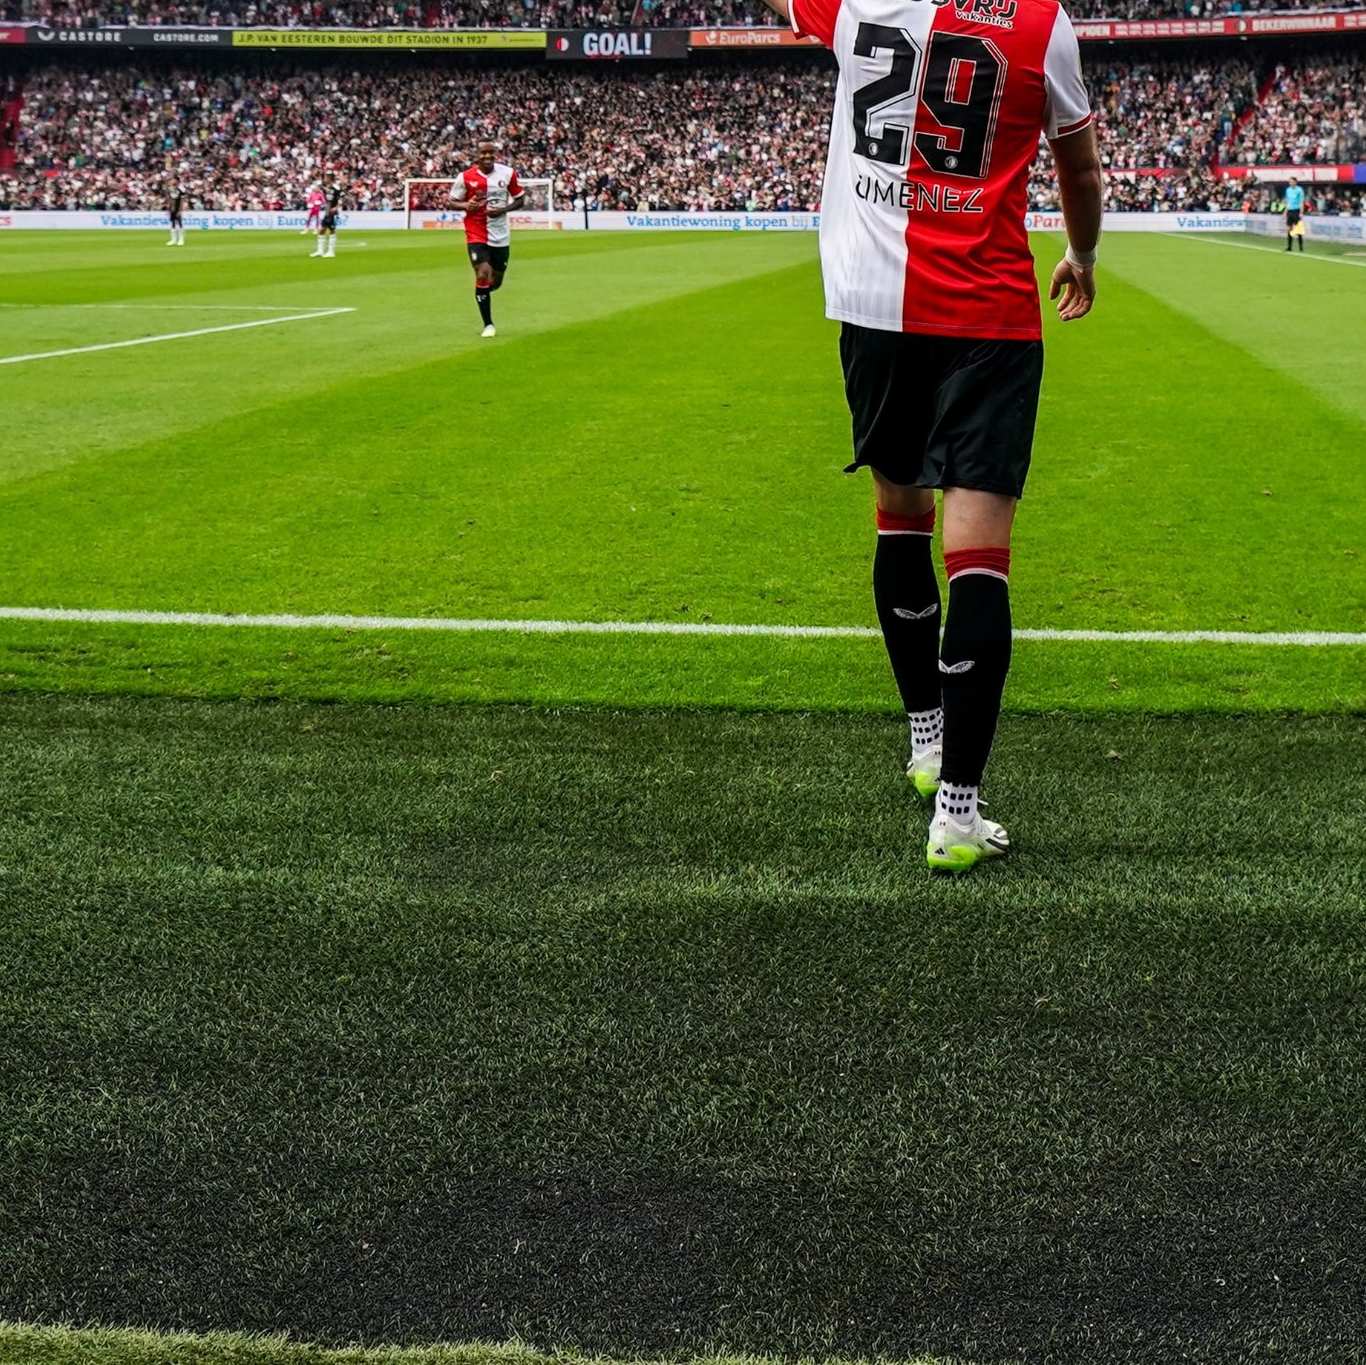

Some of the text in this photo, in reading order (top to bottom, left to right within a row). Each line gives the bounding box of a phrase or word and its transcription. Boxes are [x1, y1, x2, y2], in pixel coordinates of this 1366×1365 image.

[955, 10, 1014, 29] vakanties
[59, 32, 122, 42] CASTORE
[153, 33, 219, 42] CASTORE.COM
[258, 34, 277, 43] VAN
[281, 34, 335, 44] EESTEREN
[338, 35, 384, 44] BOUWDE
[387, 35, 403, 44] DIT
[406, 35, 450, 44] STADION
[453, 35, 463, 44] IN
[466, 35, 488, 44] 1937
[583, 32, 652, 55] GOAL!
[719, 32, 781, 44] EuroParcs
[853, 21, 1009, 179] 29
[101, 215, 209, 230] Vakantiewning
[213, 215, 254, 230] kopen
[257, 215, 275, 230] bij
[627, 215, 741, 231] Vakantiewoning
[745, 215, 788, 231] kopen
[792, 215, 809, 231] bij
